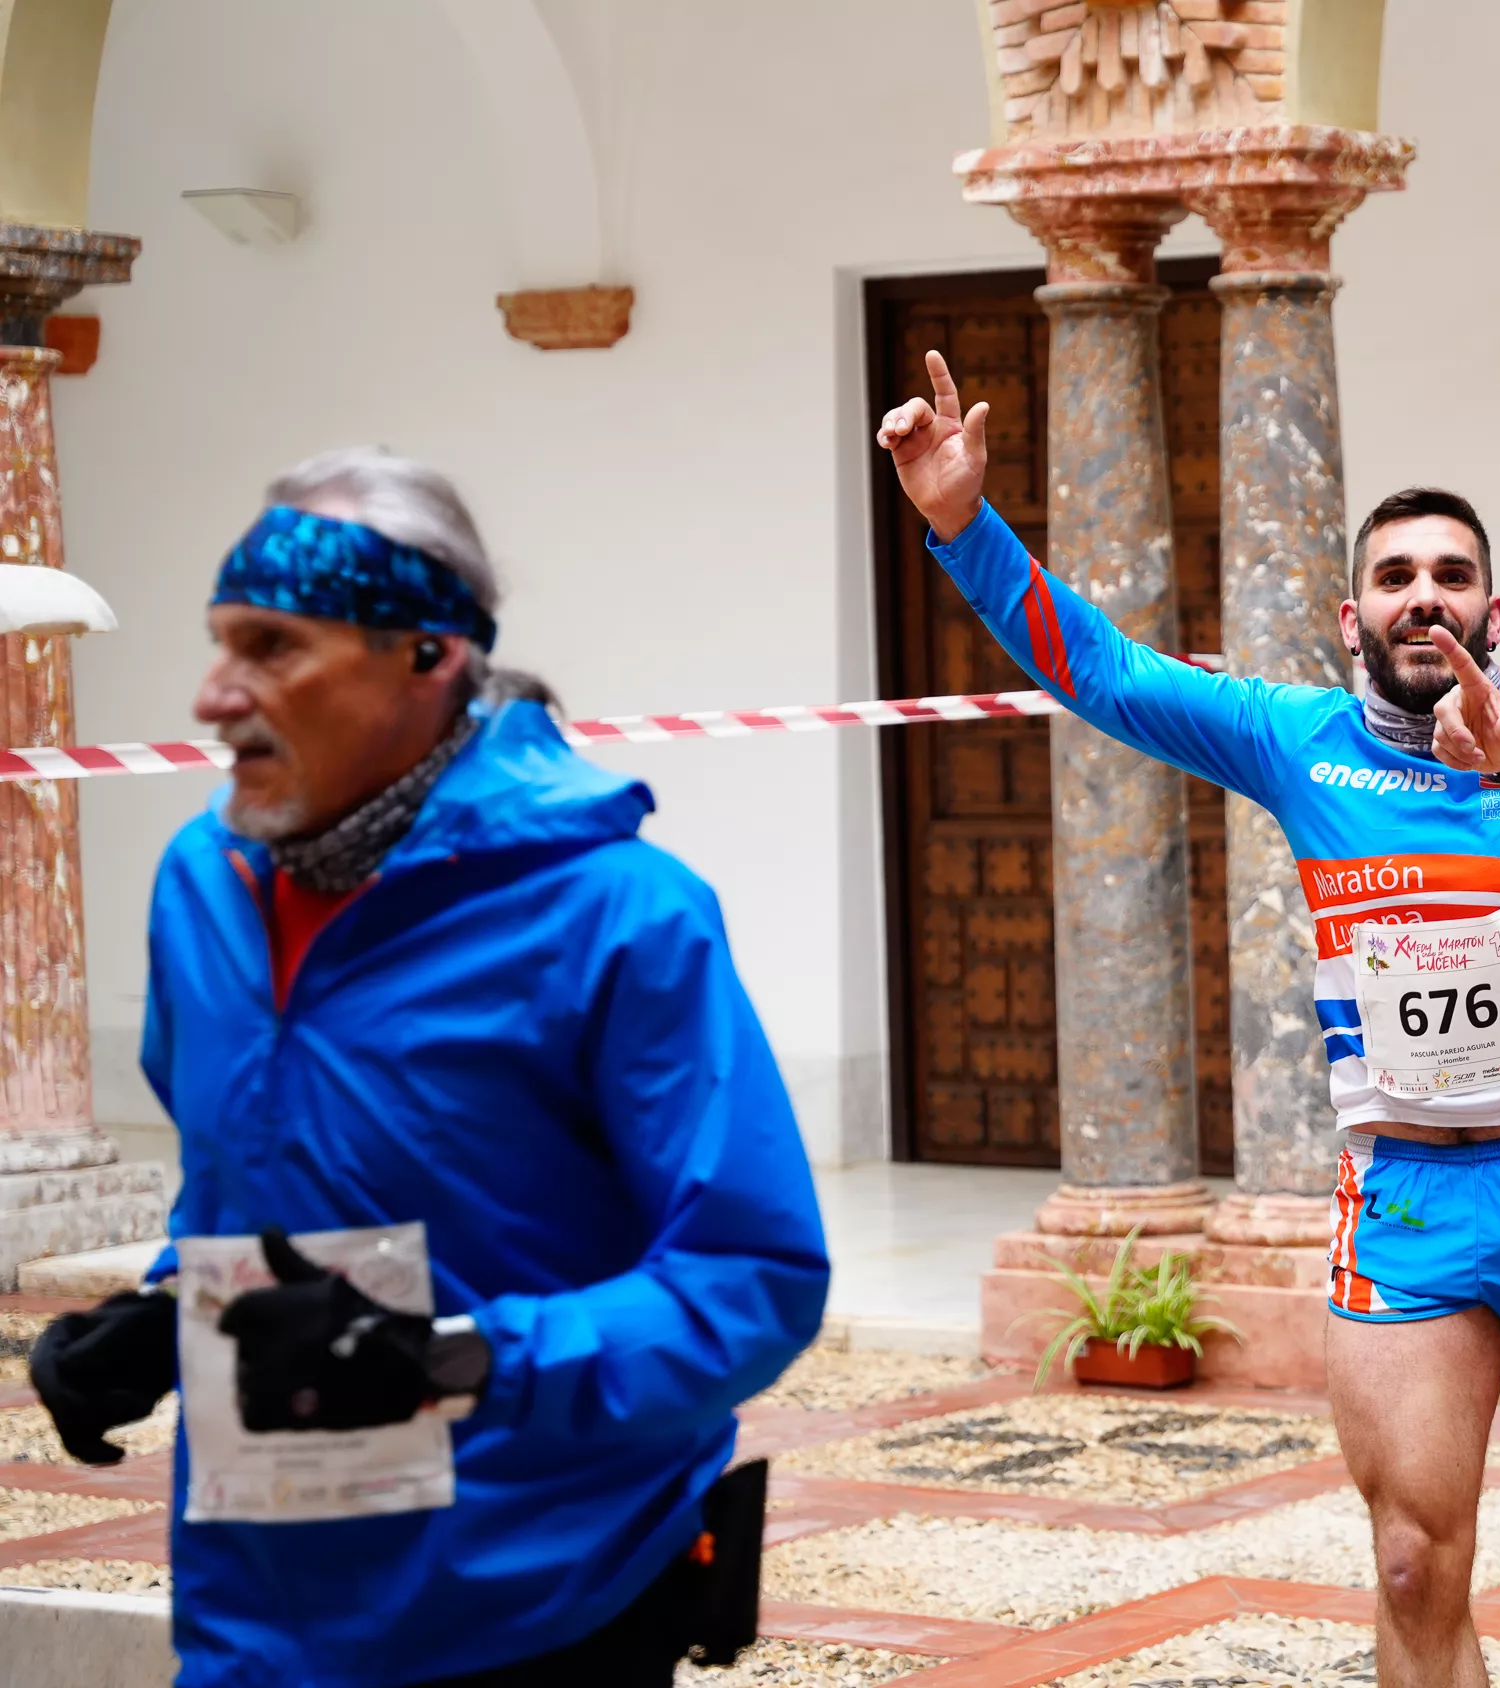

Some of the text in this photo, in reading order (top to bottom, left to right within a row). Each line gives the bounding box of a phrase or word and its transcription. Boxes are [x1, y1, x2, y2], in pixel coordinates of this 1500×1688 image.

[1309, 761, 1448, 796] enerplus
[1312, 858, 1424, 901] Maratón
[1438, 936, 1485, 952] MARATÓN
[1416, 954, 1476, 972] LUCENA
[1399, 983, 1499, 1037] 676
[1410, 1040, 1496, 1059] PASCUAL PAREJO AGUILAR
[1437, 1055, 1470, 1066] L-Hombre
